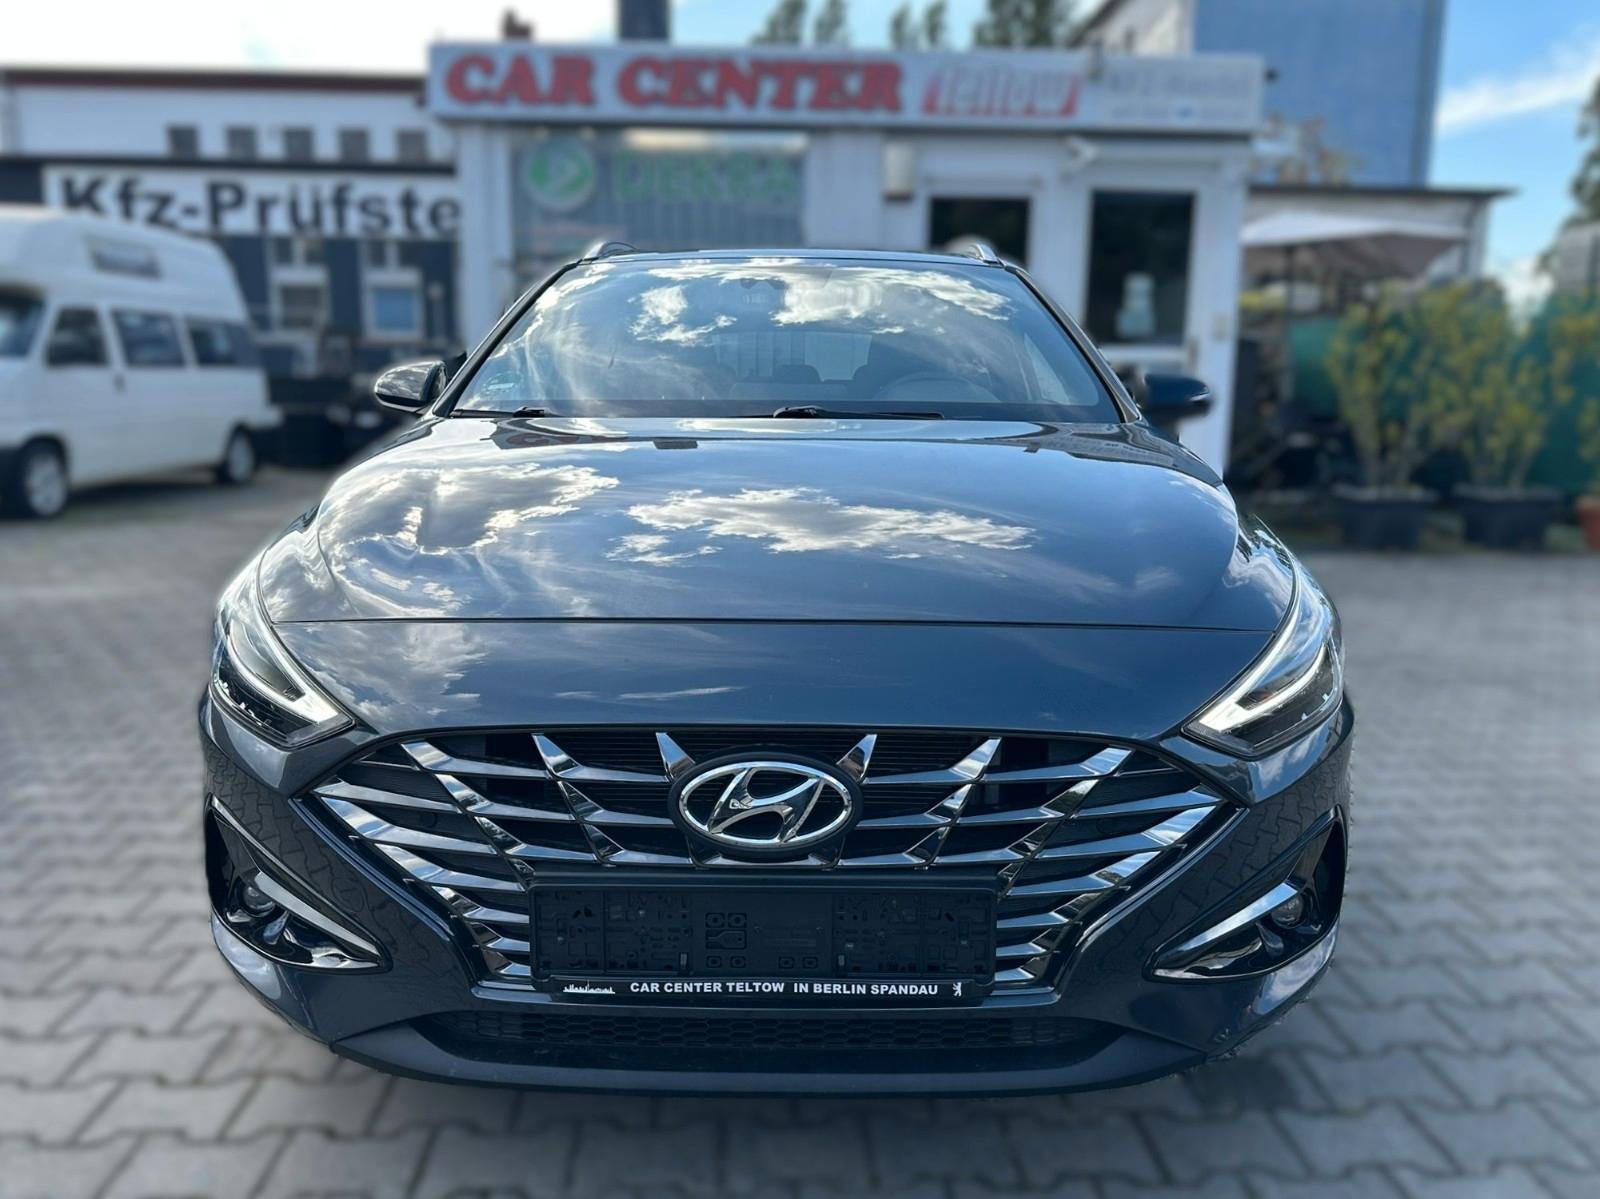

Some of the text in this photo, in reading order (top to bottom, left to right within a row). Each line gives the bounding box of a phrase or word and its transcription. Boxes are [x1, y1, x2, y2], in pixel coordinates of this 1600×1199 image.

[446, 54, 596, 106] CAR
[618, 57, 903, 113] CENTER
[630, 982, 938, 995] CAR CENTER TELTOW IN BERLIN SPANDAU
